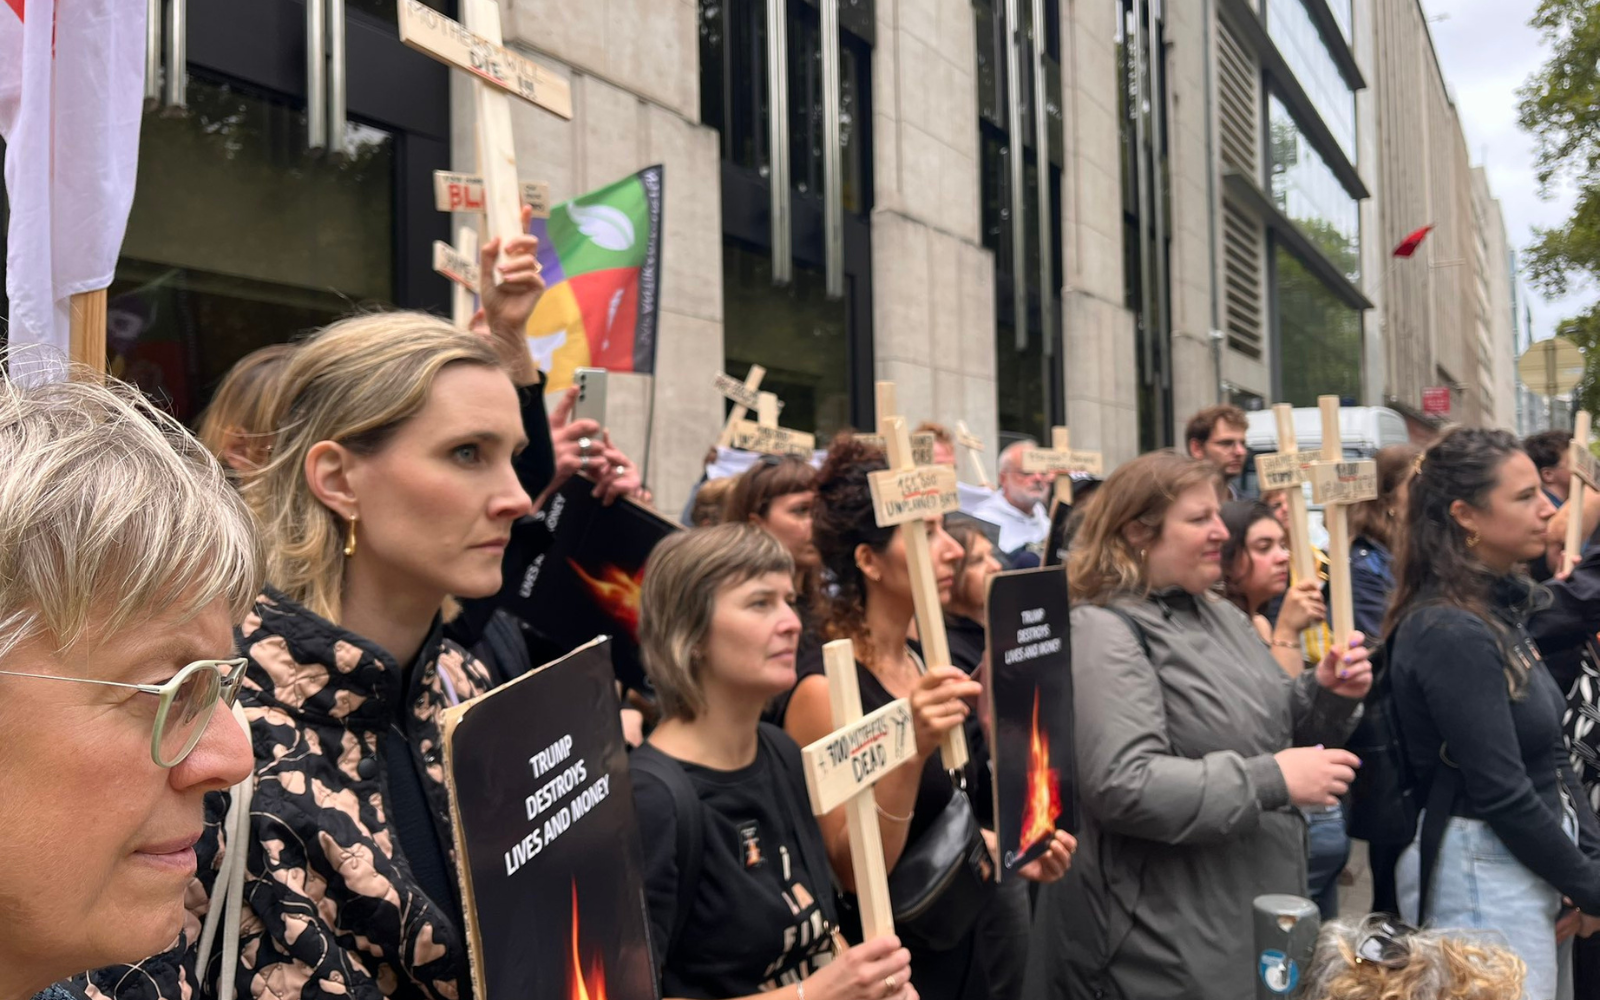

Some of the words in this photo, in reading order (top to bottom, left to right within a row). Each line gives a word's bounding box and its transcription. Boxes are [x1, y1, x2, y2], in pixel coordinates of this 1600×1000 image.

[519, 563, 540, 599] LIVES
[1020, 607, 1046, 625] TRUMP
[1004, 646, 1025, 666] LIVES
[1024, 642, 1039, 660] AND
[1038, 637, 1062, 656] MONEY
[528, 733, 573, 779] TRUMP
[851, 743, 887, 783] DEAD
[525, 758, 588, 821] DESTROYS
[503, 827, 543, 877] LIVES
[543, 806, 572, 847] AND
[570, 772, 610, 823] MONEY
